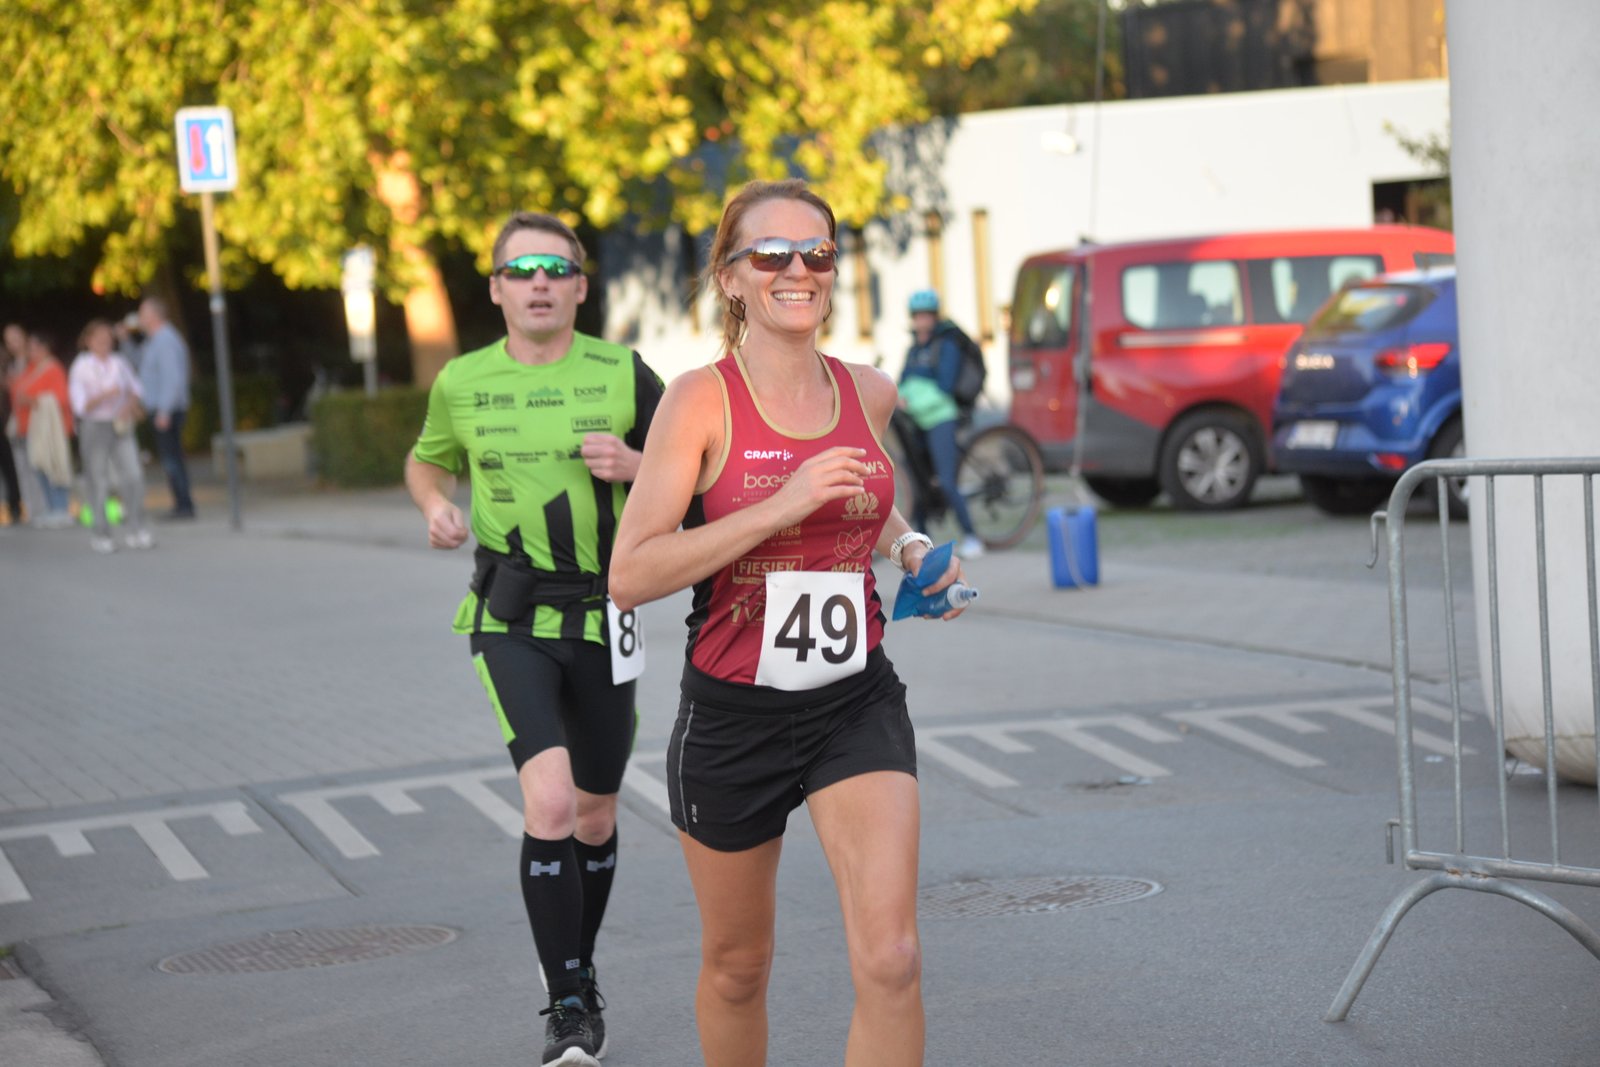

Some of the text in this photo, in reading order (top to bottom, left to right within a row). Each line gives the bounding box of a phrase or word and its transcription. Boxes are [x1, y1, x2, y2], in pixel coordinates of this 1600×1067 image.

[744, 449, 782, 460] CRAFT
[618, 608, 642, 658] 8
[774, 593, 858, 664] 49
